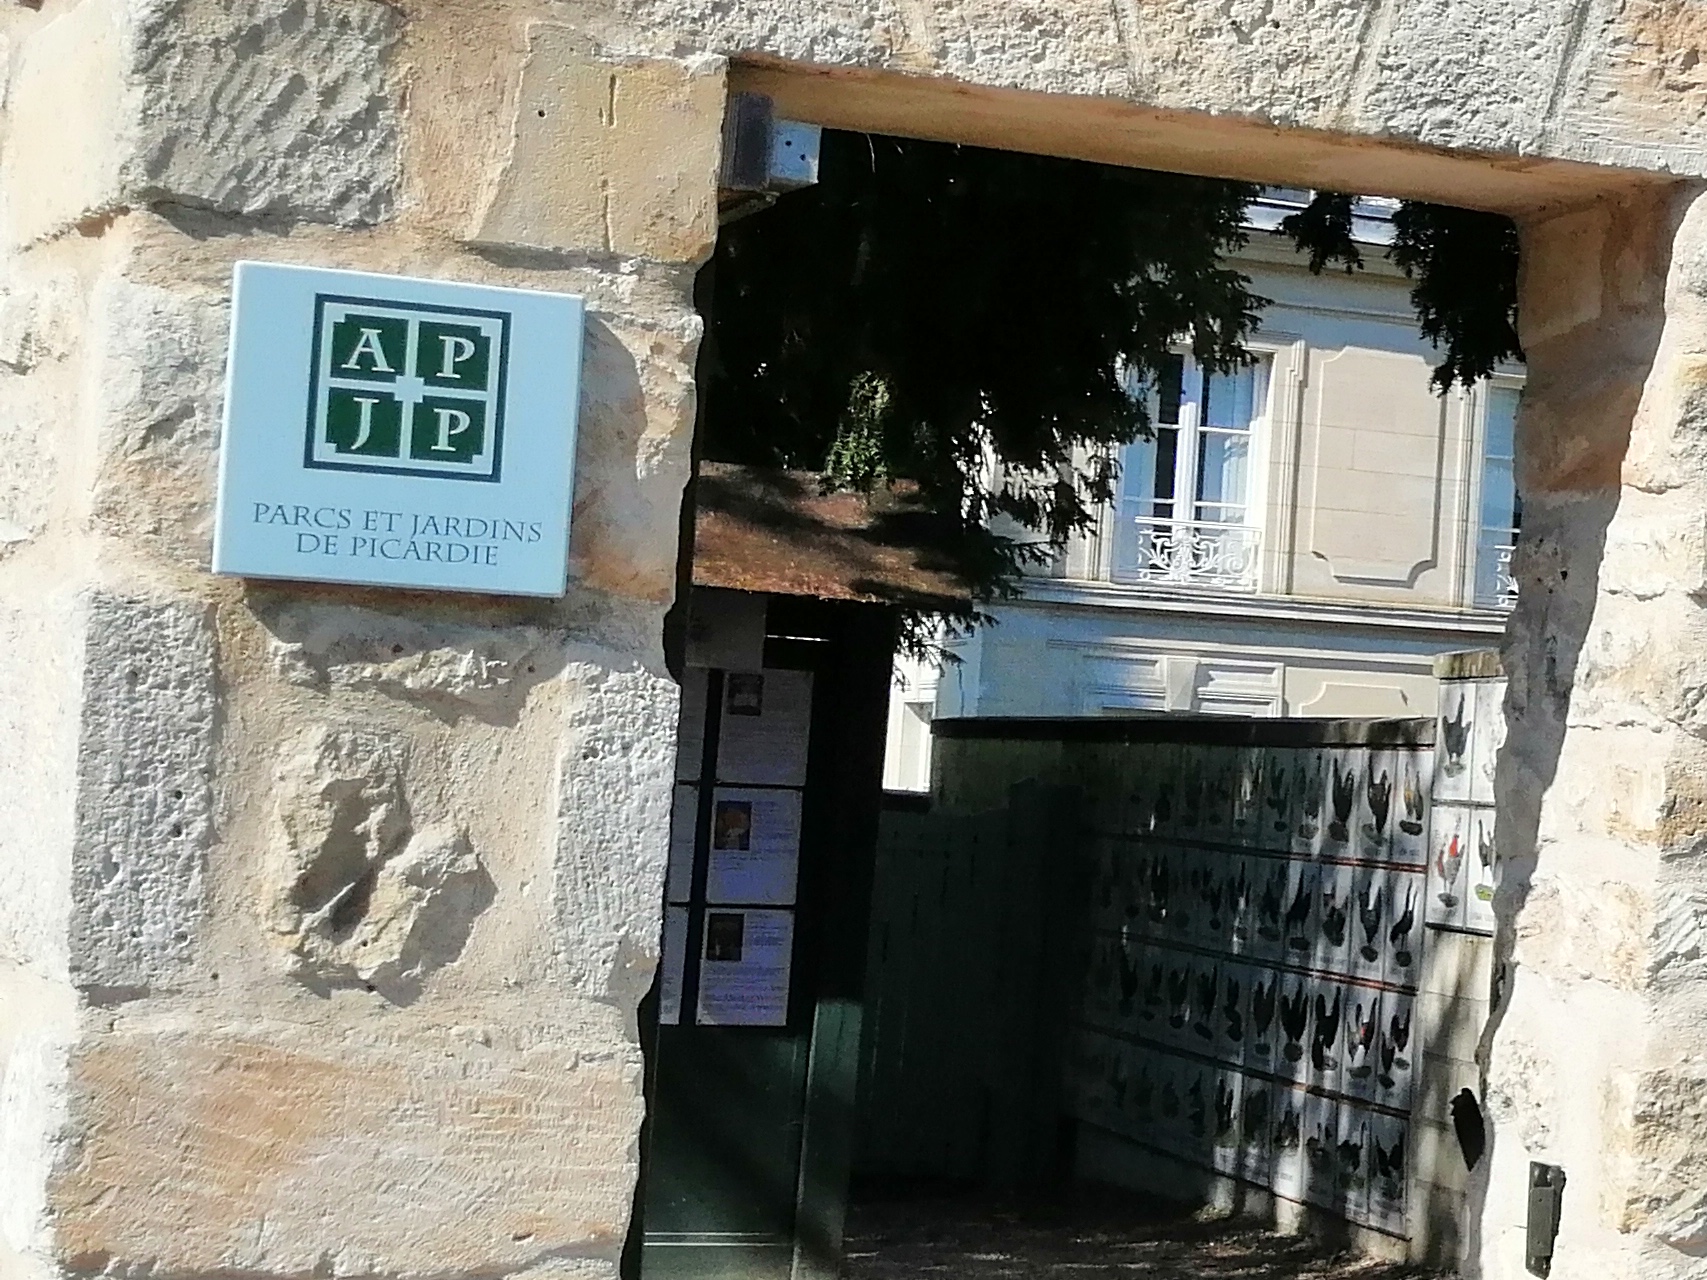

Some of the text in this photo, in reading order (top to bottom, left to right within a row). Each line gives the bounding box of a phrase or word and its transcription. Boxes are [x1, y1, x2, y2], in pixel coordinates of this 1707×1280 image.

[253, 502, 543, 543] PARCS ET JARDINS
[297, 532, 498, 566] DE PICARDIE
